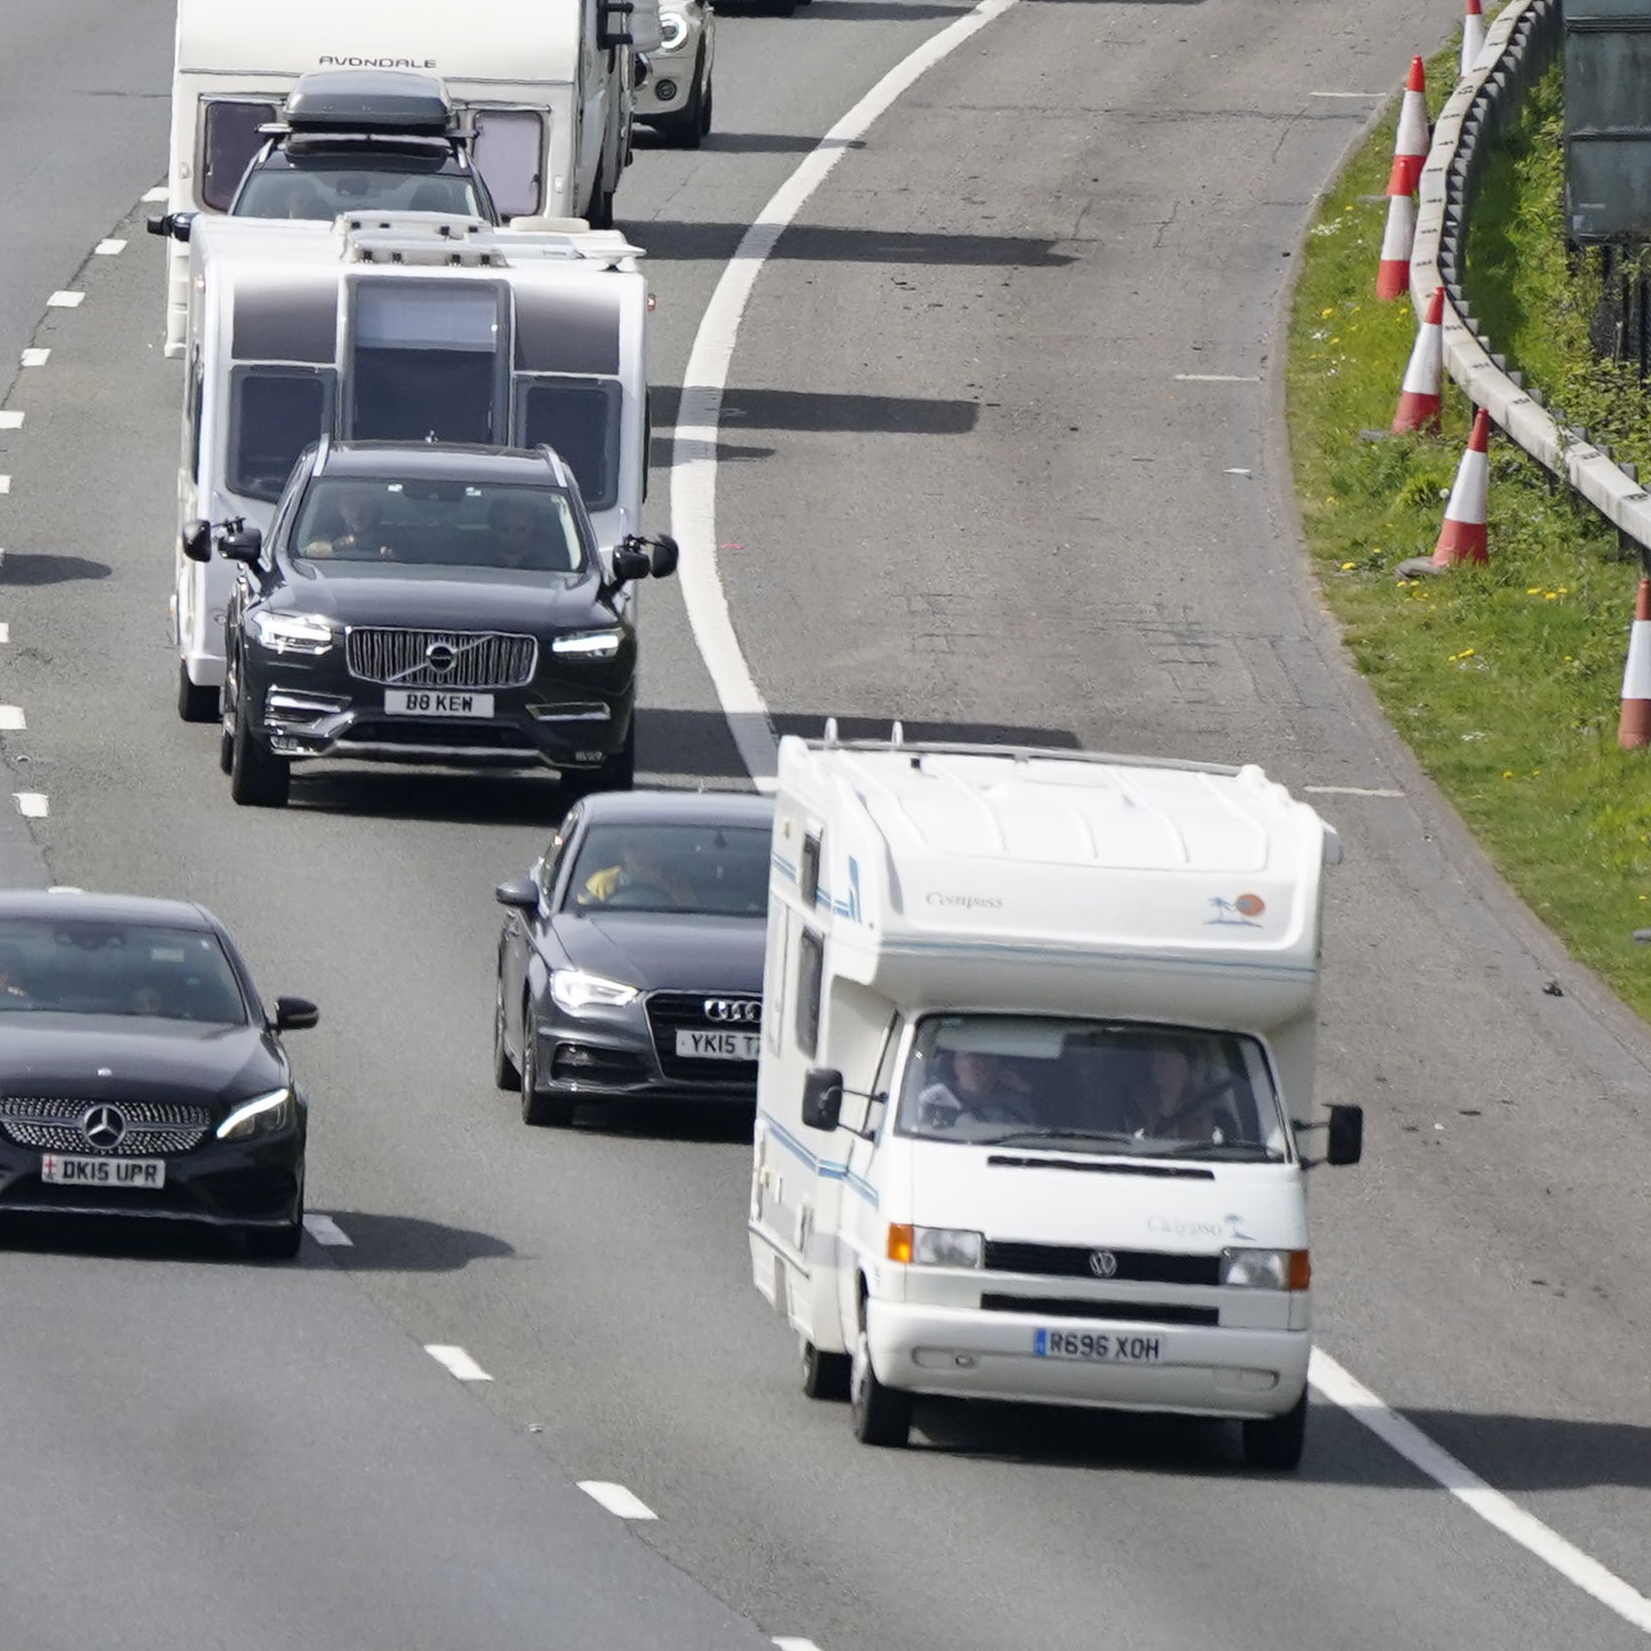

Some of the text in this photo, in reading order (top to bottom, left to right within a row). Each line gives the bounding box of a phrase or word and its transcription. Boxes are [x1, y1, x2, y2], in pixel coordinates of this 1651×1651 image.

[319, 55, 436, 69] AVONDALE
[925, 890, 1004, 910] Compass
[690, 1033, 737, 1054] YK15
[62, 1160, 159, 1184] DK15 UPR
[1049, 1332, 1161, 1361] R696 XOH
